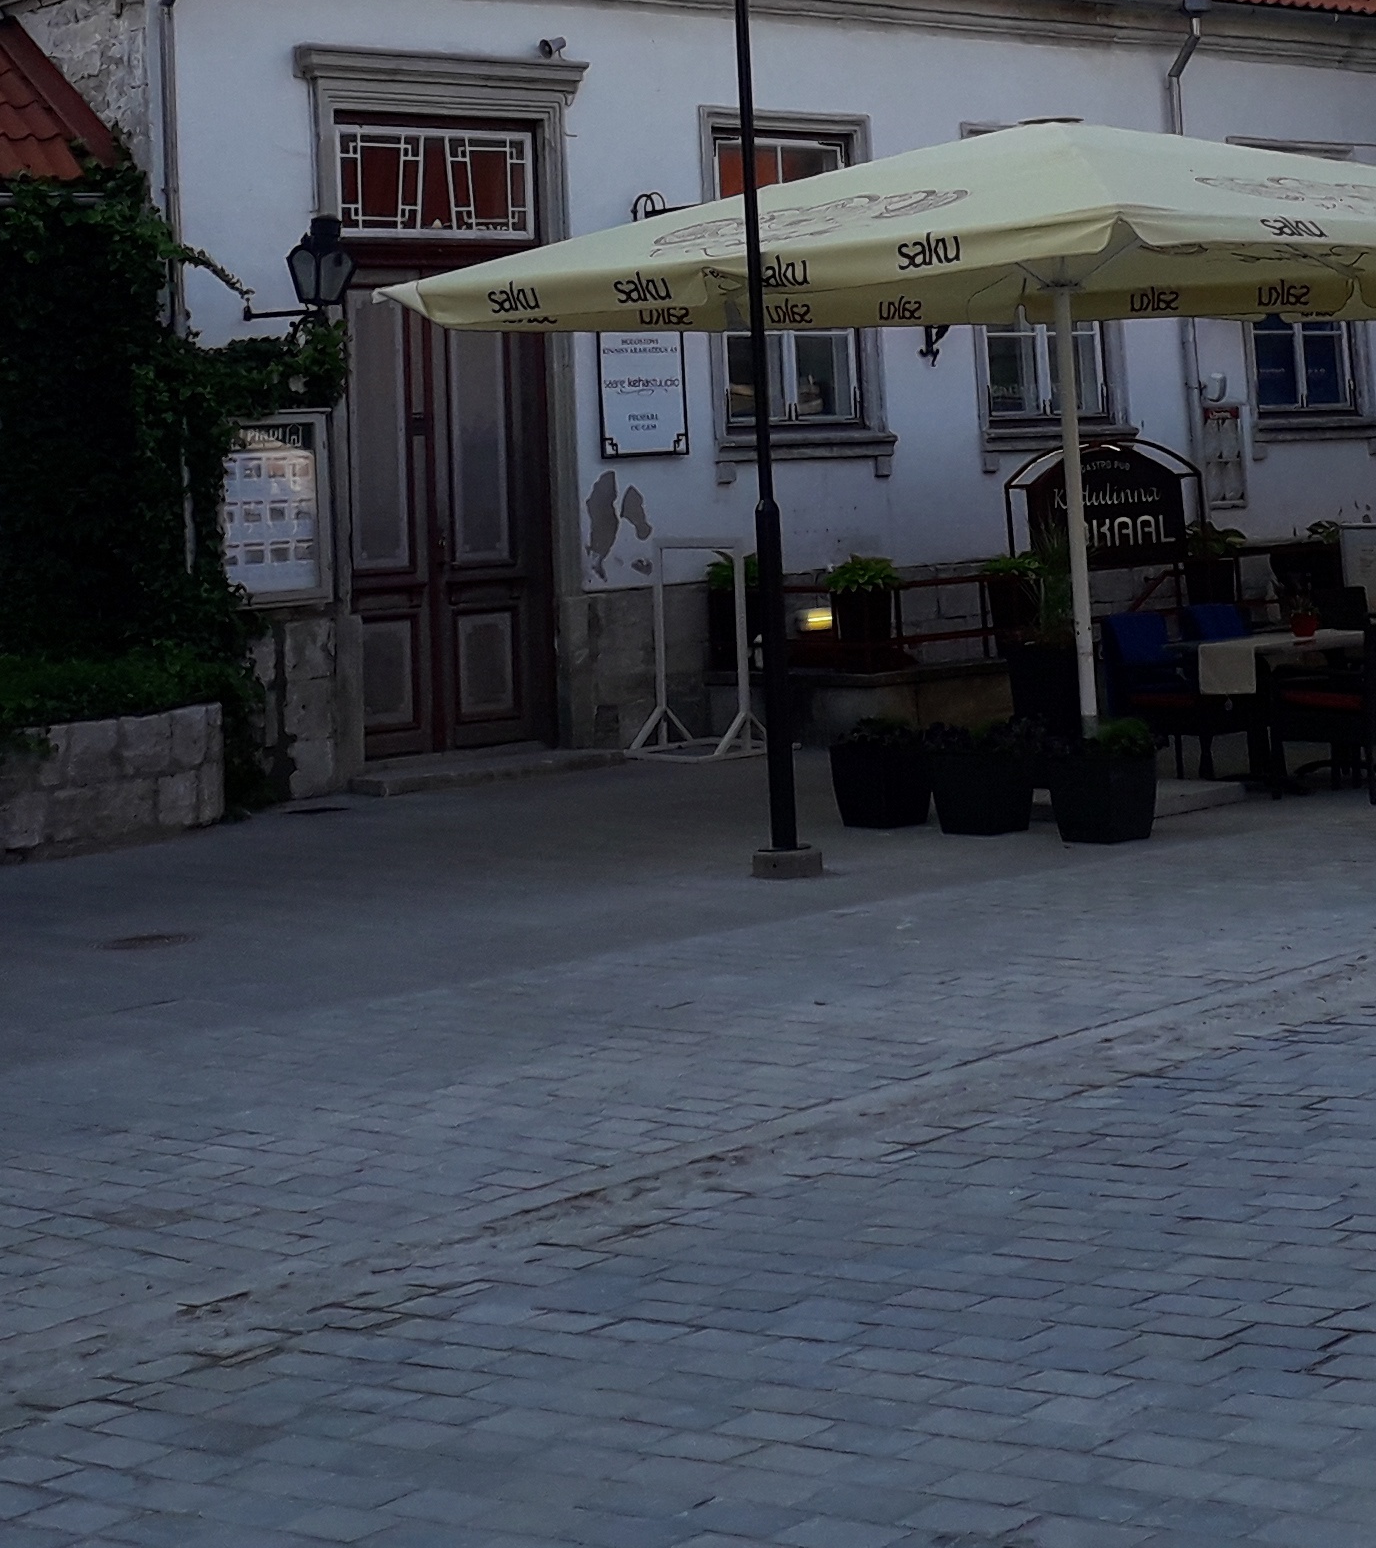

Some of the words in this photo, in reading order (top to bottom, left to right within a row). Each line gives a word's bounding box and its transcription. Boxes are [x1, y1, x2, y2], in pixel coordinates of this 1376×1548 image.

[1260, 216, 1329, 238] saku
[898, 232, 961, 271] saku
[488, 280, 540, 313] saku
[614, 271, 672, 303] saku
[1053, 483, 1162, 510] Kdulinna
